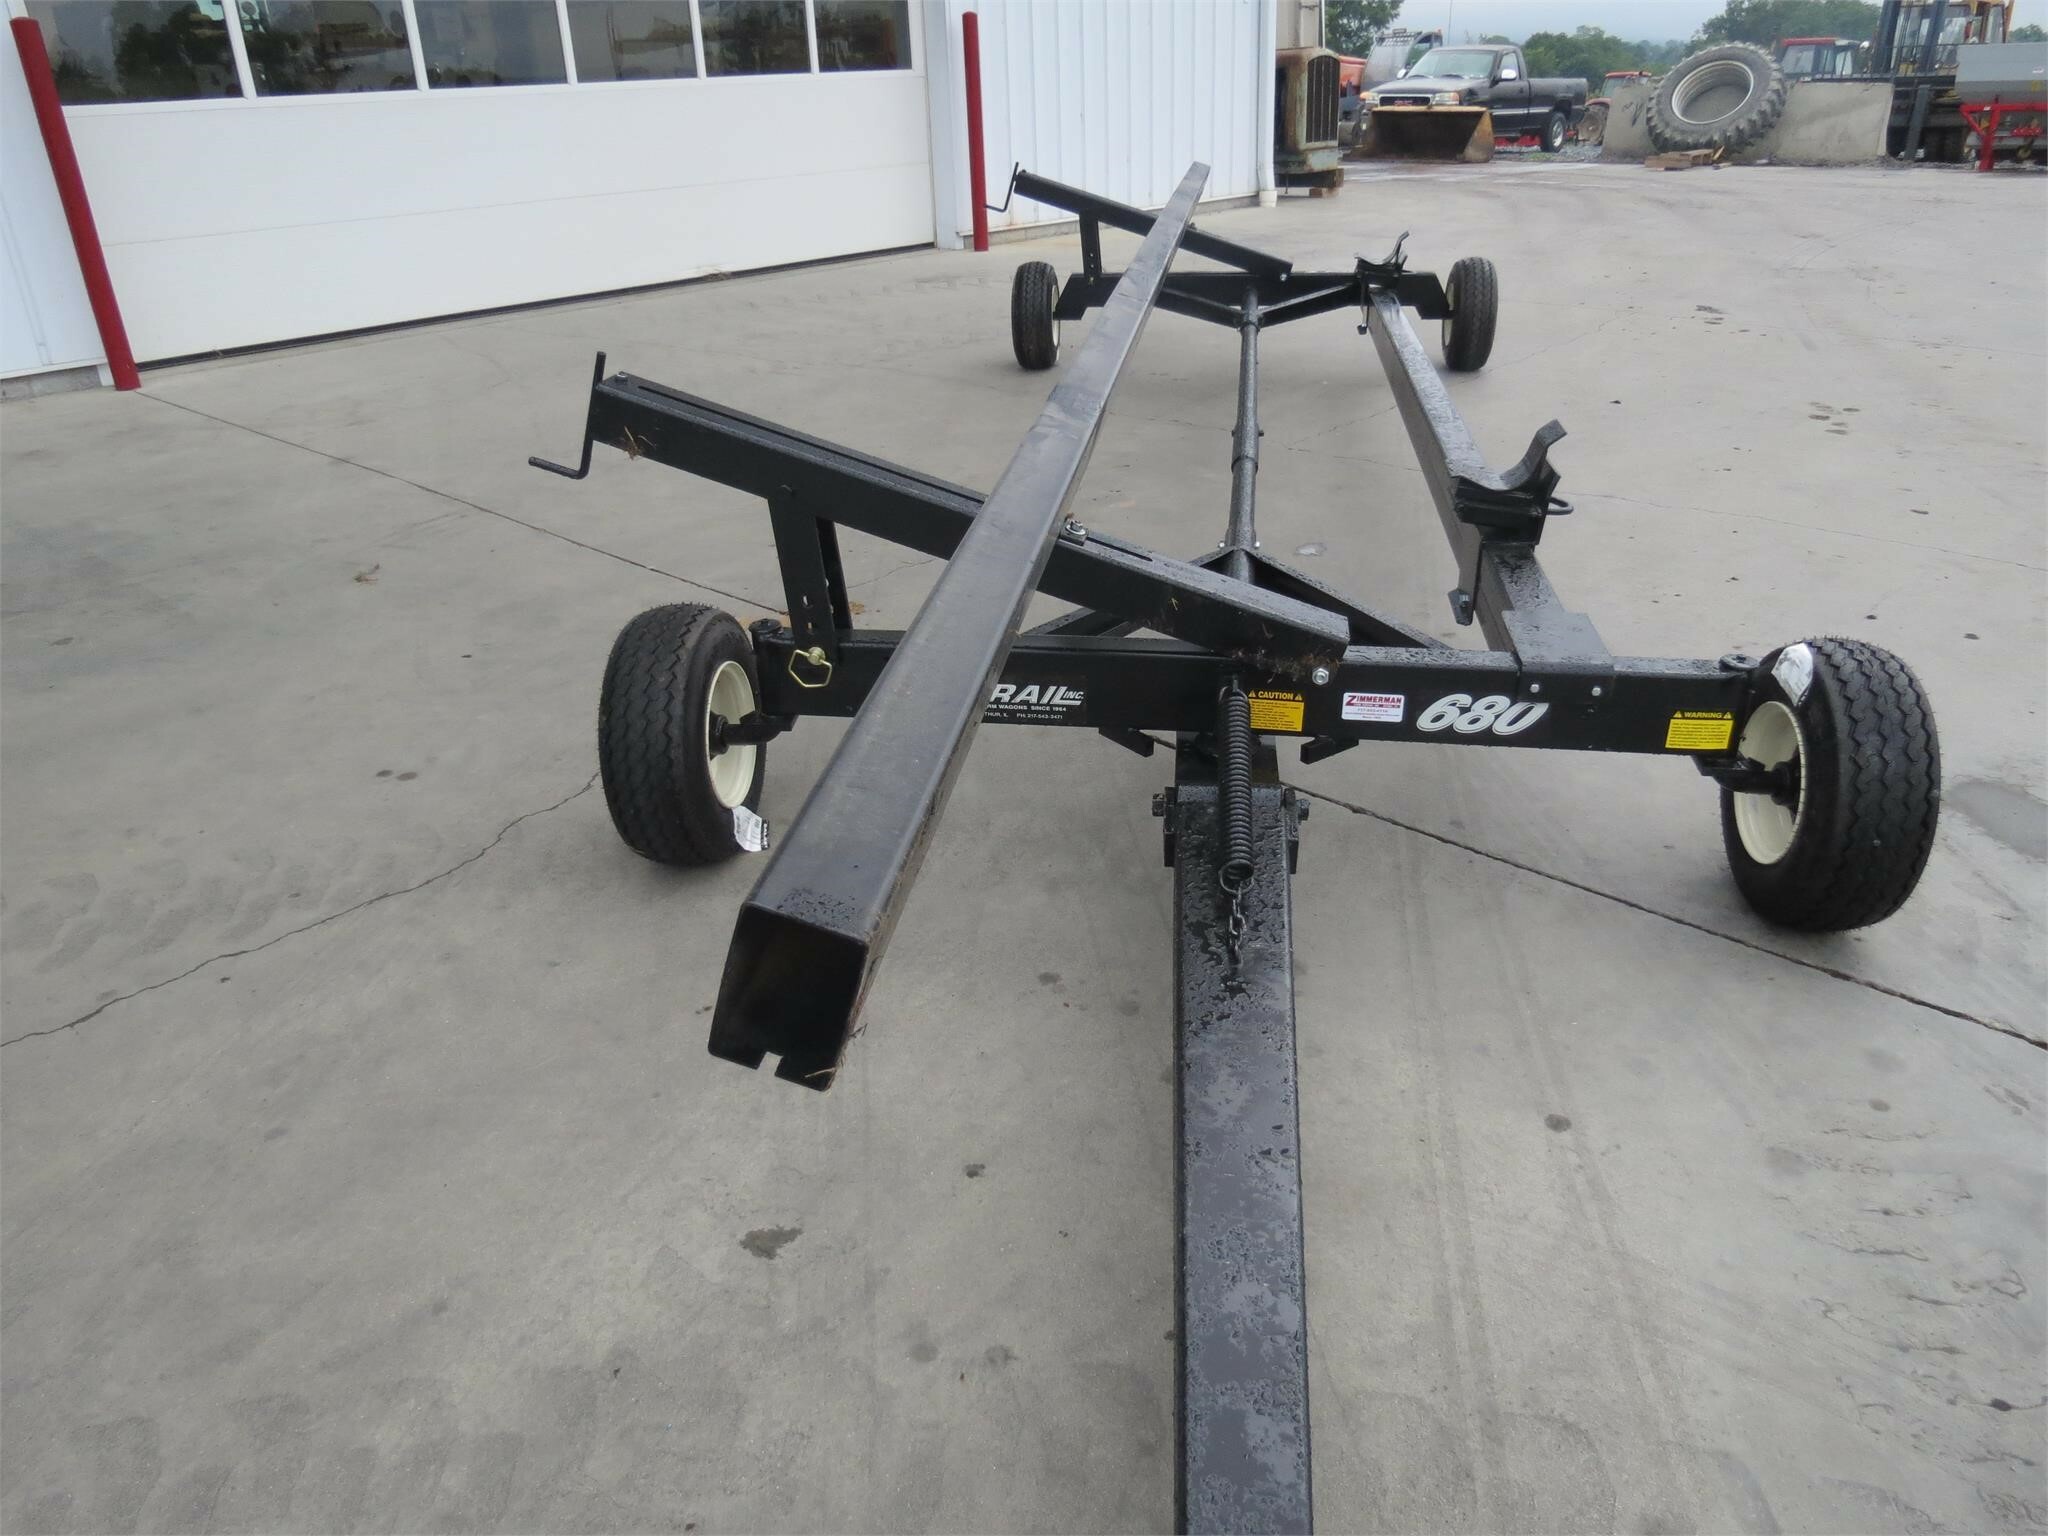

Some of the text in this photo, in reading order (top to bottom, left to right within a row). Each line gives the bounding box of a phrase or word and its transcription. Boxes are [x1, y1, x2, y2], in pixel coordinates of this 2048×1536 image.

[989, 684, 1081, 706] RAIL
[1258, 691, 1294, 700] CAUTION
[1345, 695, 1402, 706] ZIMMERMAN
[1416, 693, 1549, 735] 680
